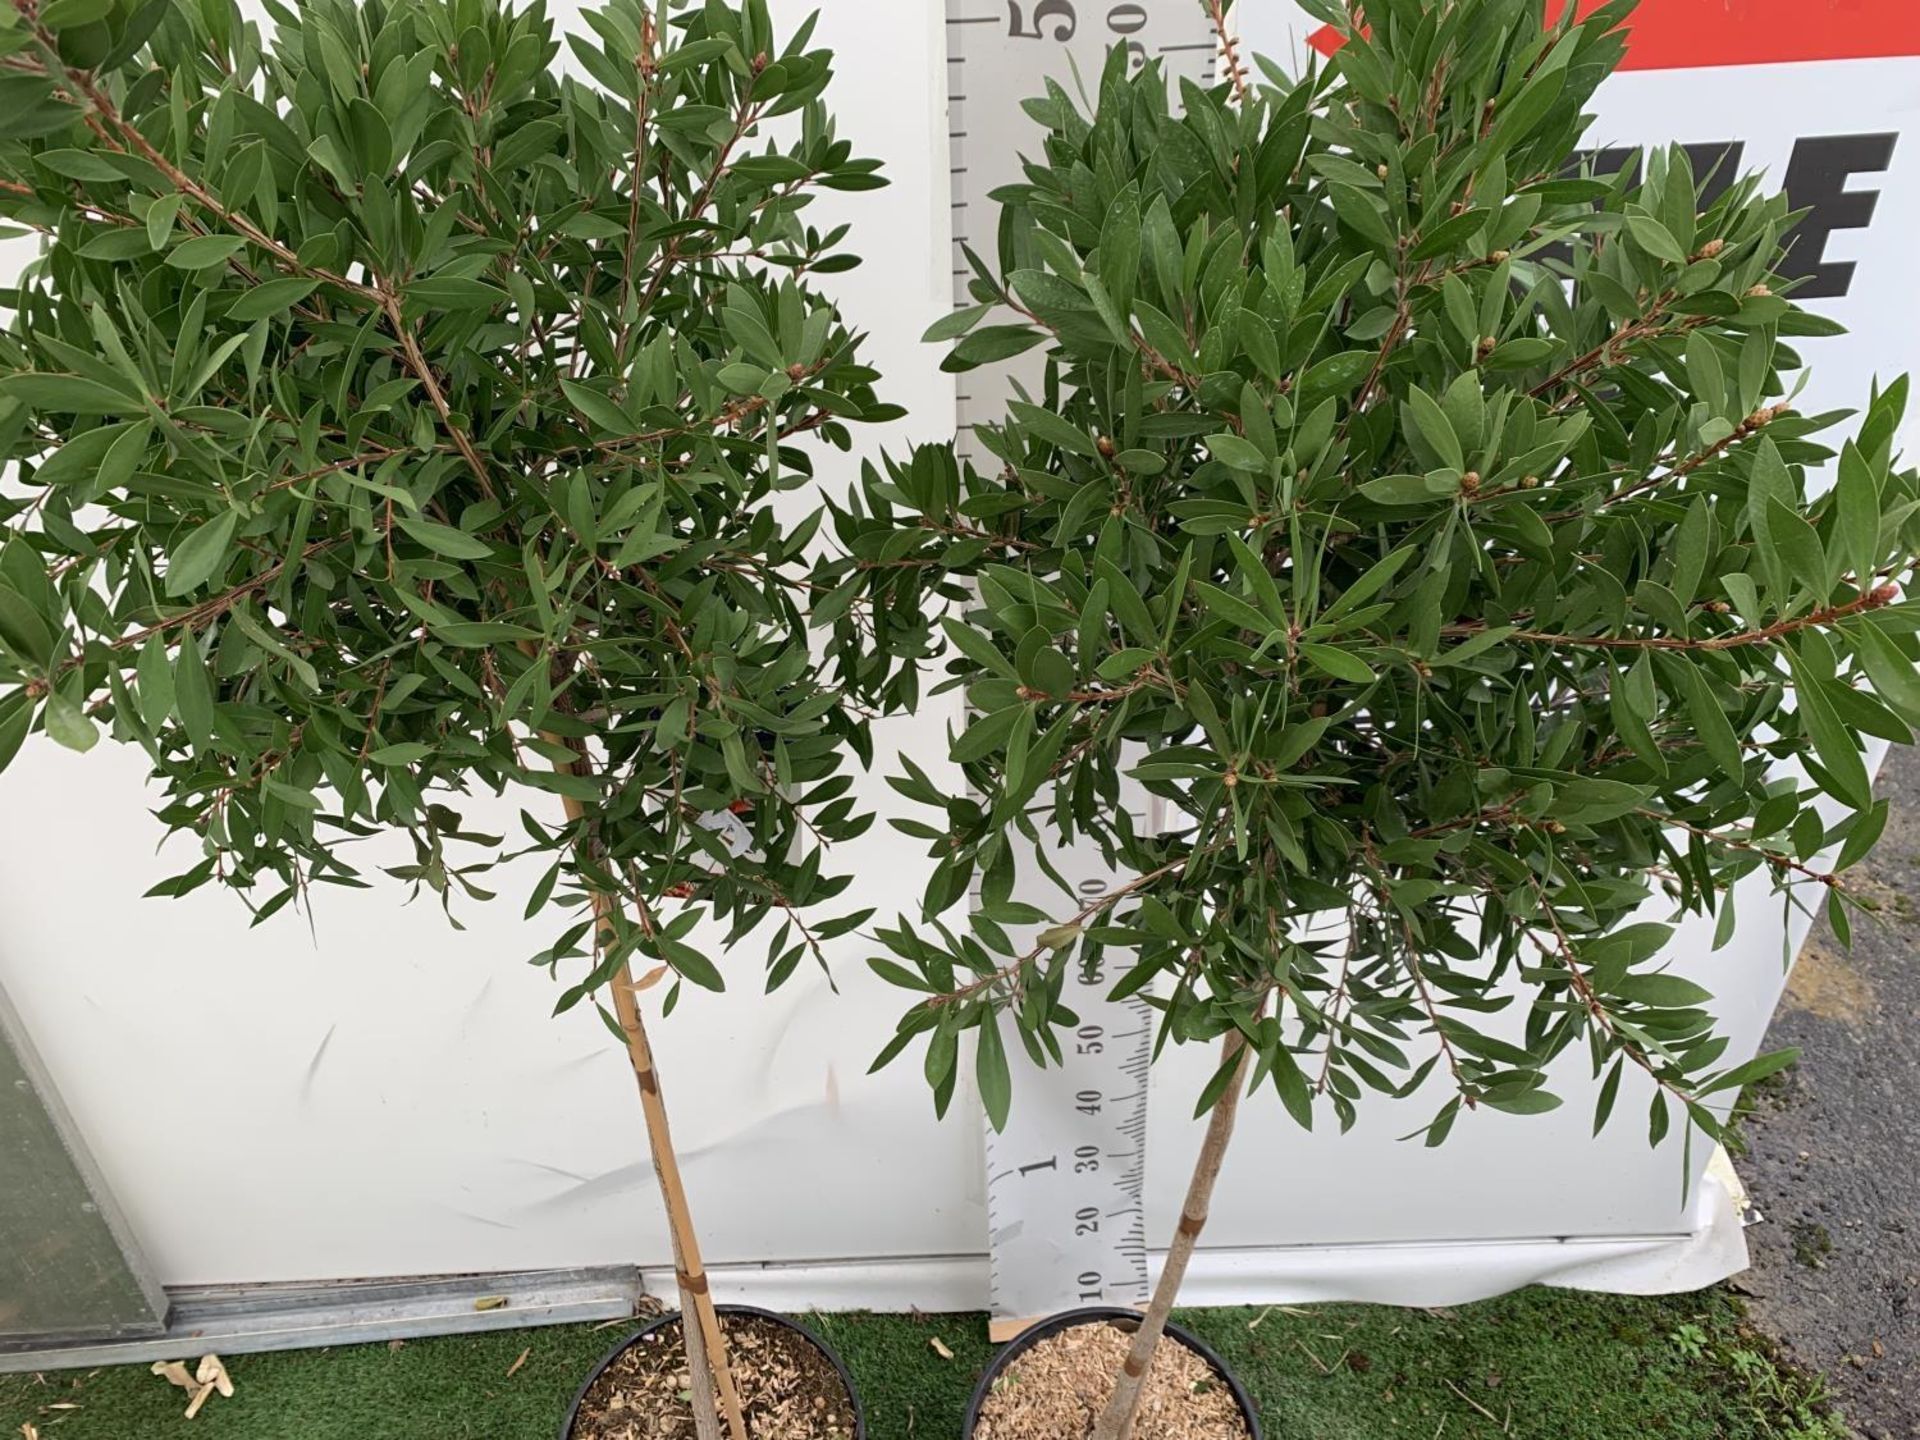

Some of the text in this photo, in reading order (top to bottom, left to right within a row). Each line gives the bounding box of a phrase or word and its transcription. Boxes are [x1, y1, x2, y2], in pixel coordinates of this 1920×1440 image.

[1008, 0, 1076, 41] 5
[1076, 1025, 1104, 1055] 50
[1076, 1090, 1102, 1116] 40
[1018, 1155, 1057, 1177] 1
[1074, 1145, 1100, 1174] 30
[1075, 1207, 1100, 1236] 20
[1077, 1271, 1103, 1301] 10
